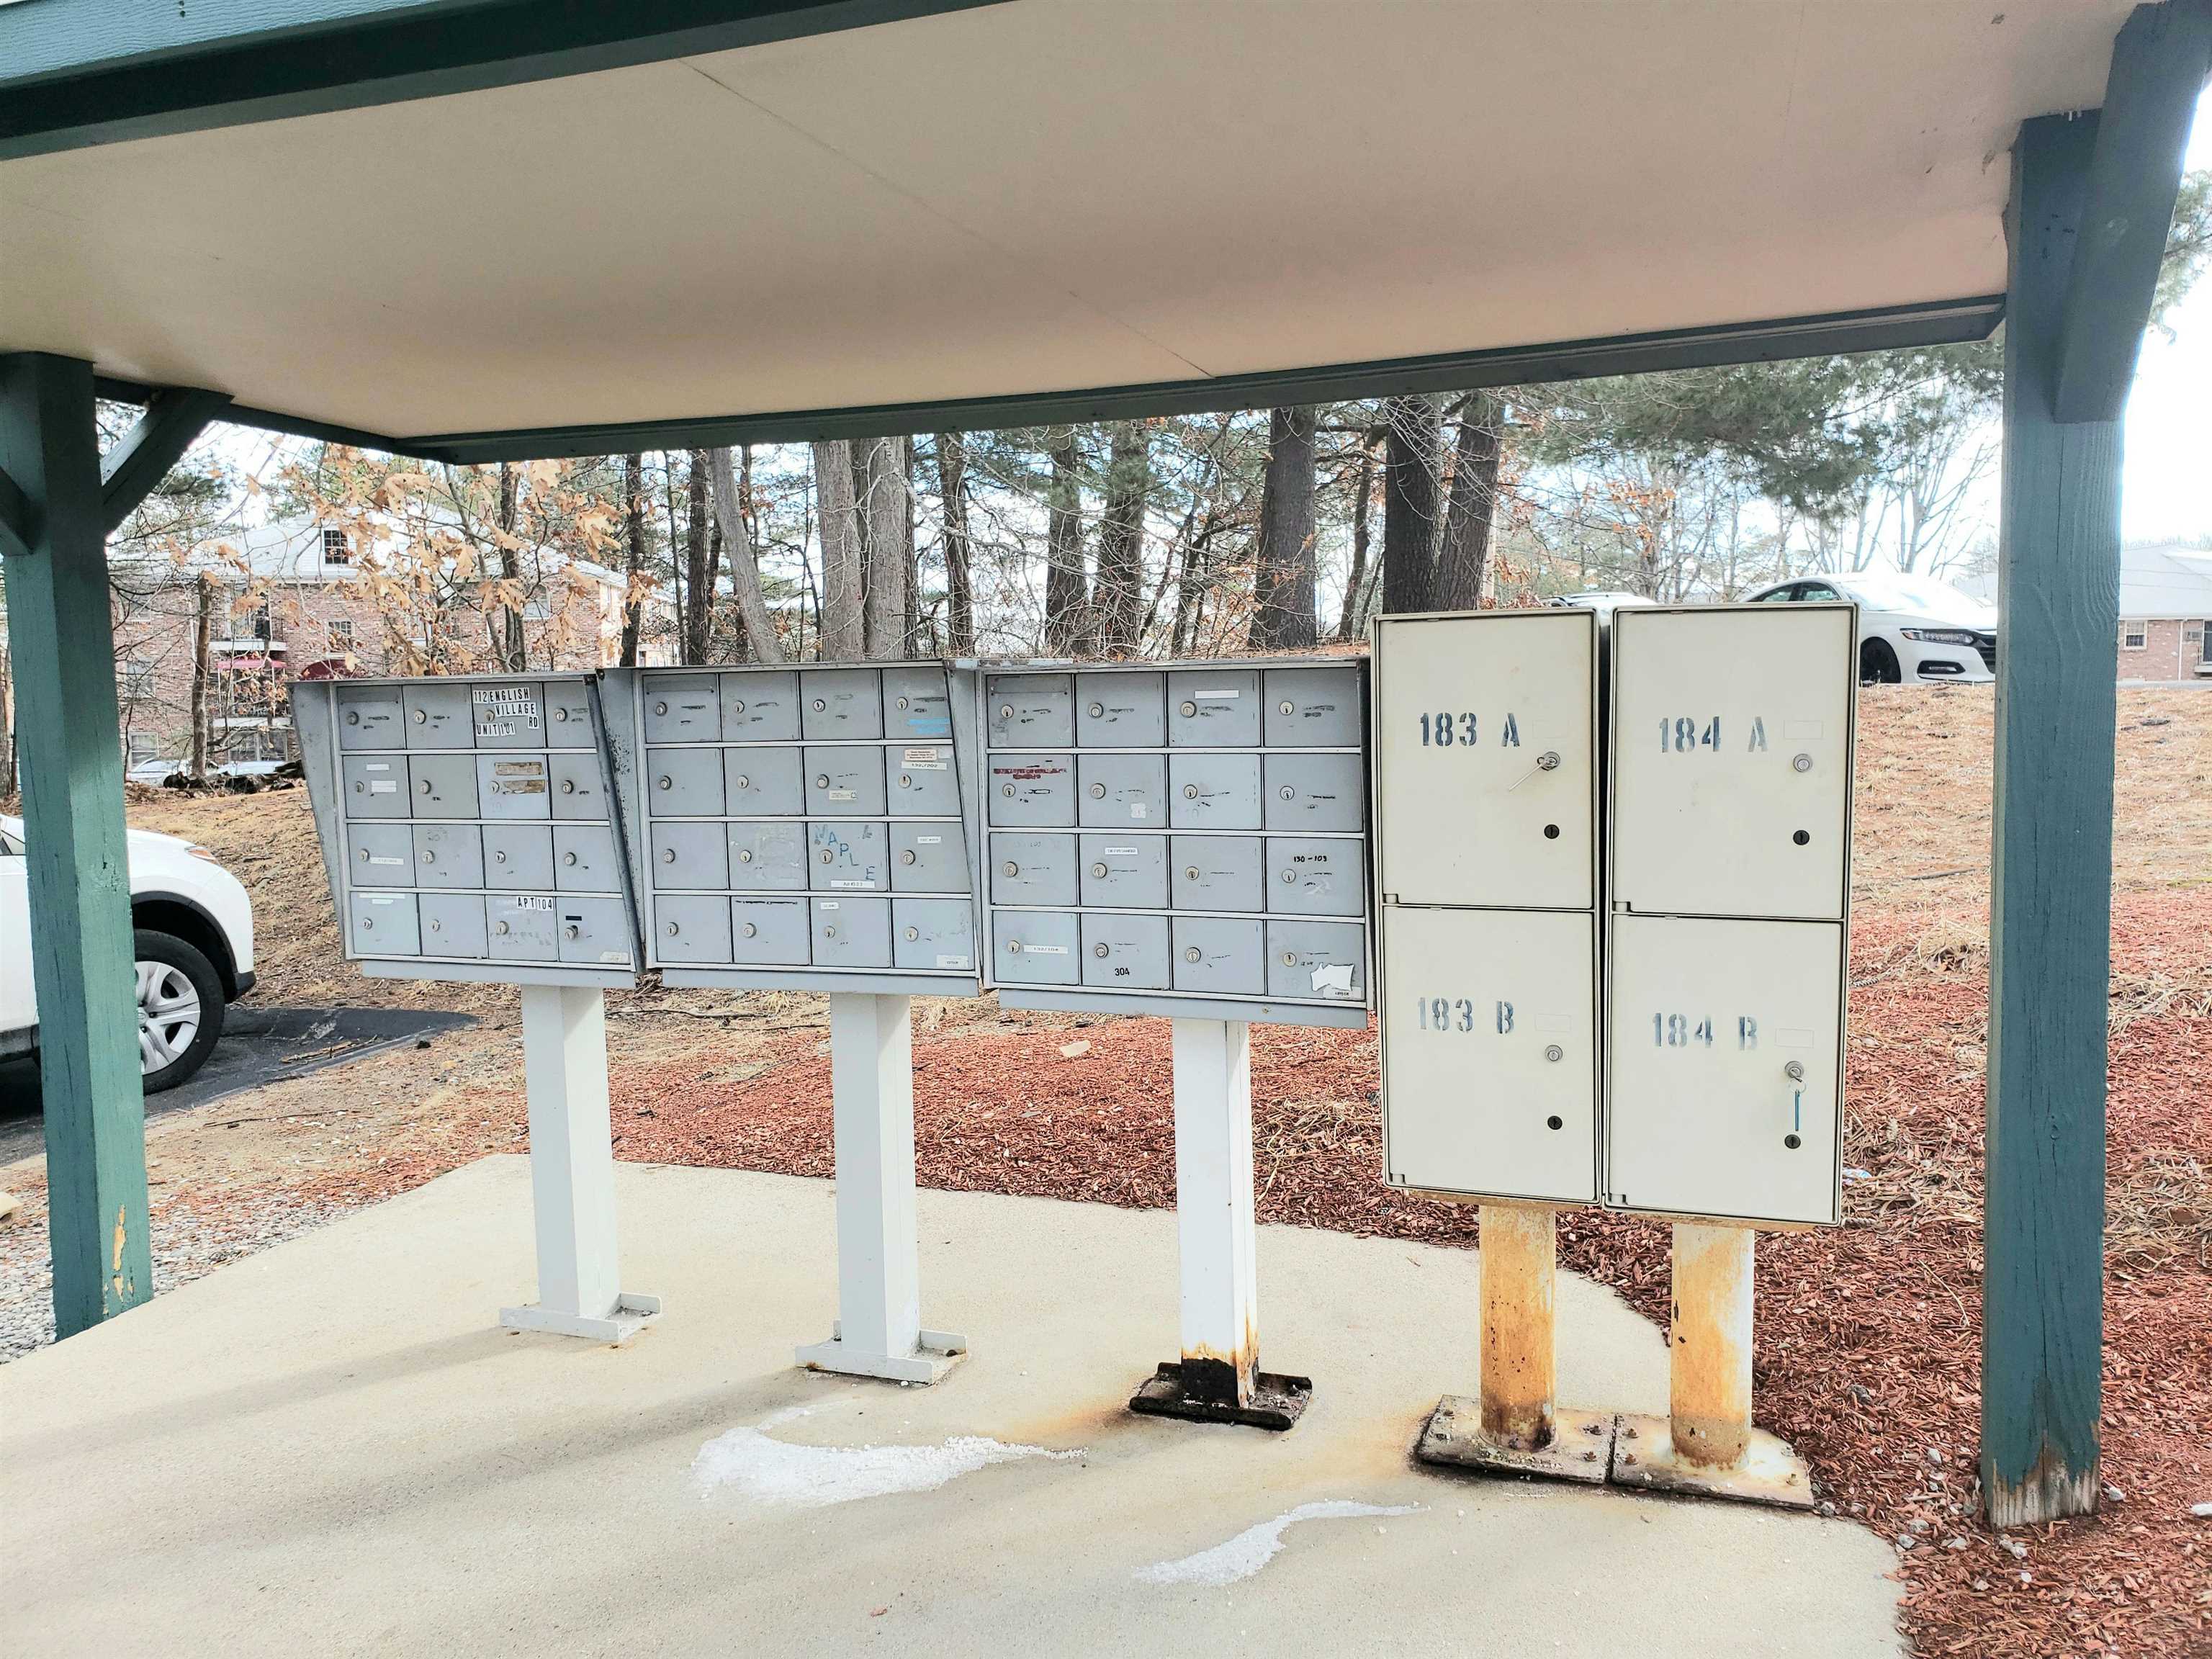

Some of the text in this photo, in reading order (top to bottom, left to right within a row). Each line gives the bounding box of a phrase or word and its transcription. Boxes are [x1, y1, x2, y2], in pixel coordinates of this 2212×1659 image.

[474, 688, 529, 703] 112 ENGLISH
[495, 703, 535, 716] VILLAGE
[528, 716, 539, 727] RD
[477, 724, 497, 735] UNIT
[1420, 711, 1520, 747] 183 A
[1659, 716, 1768, 753] 184 A
[518, 897, 552, 909] APT 104
[1115, 967, 1130, 976] 304
[1417, 997, 1514, 1034] 183 B
[1652, 1012, 1758, 1051] 184 B
